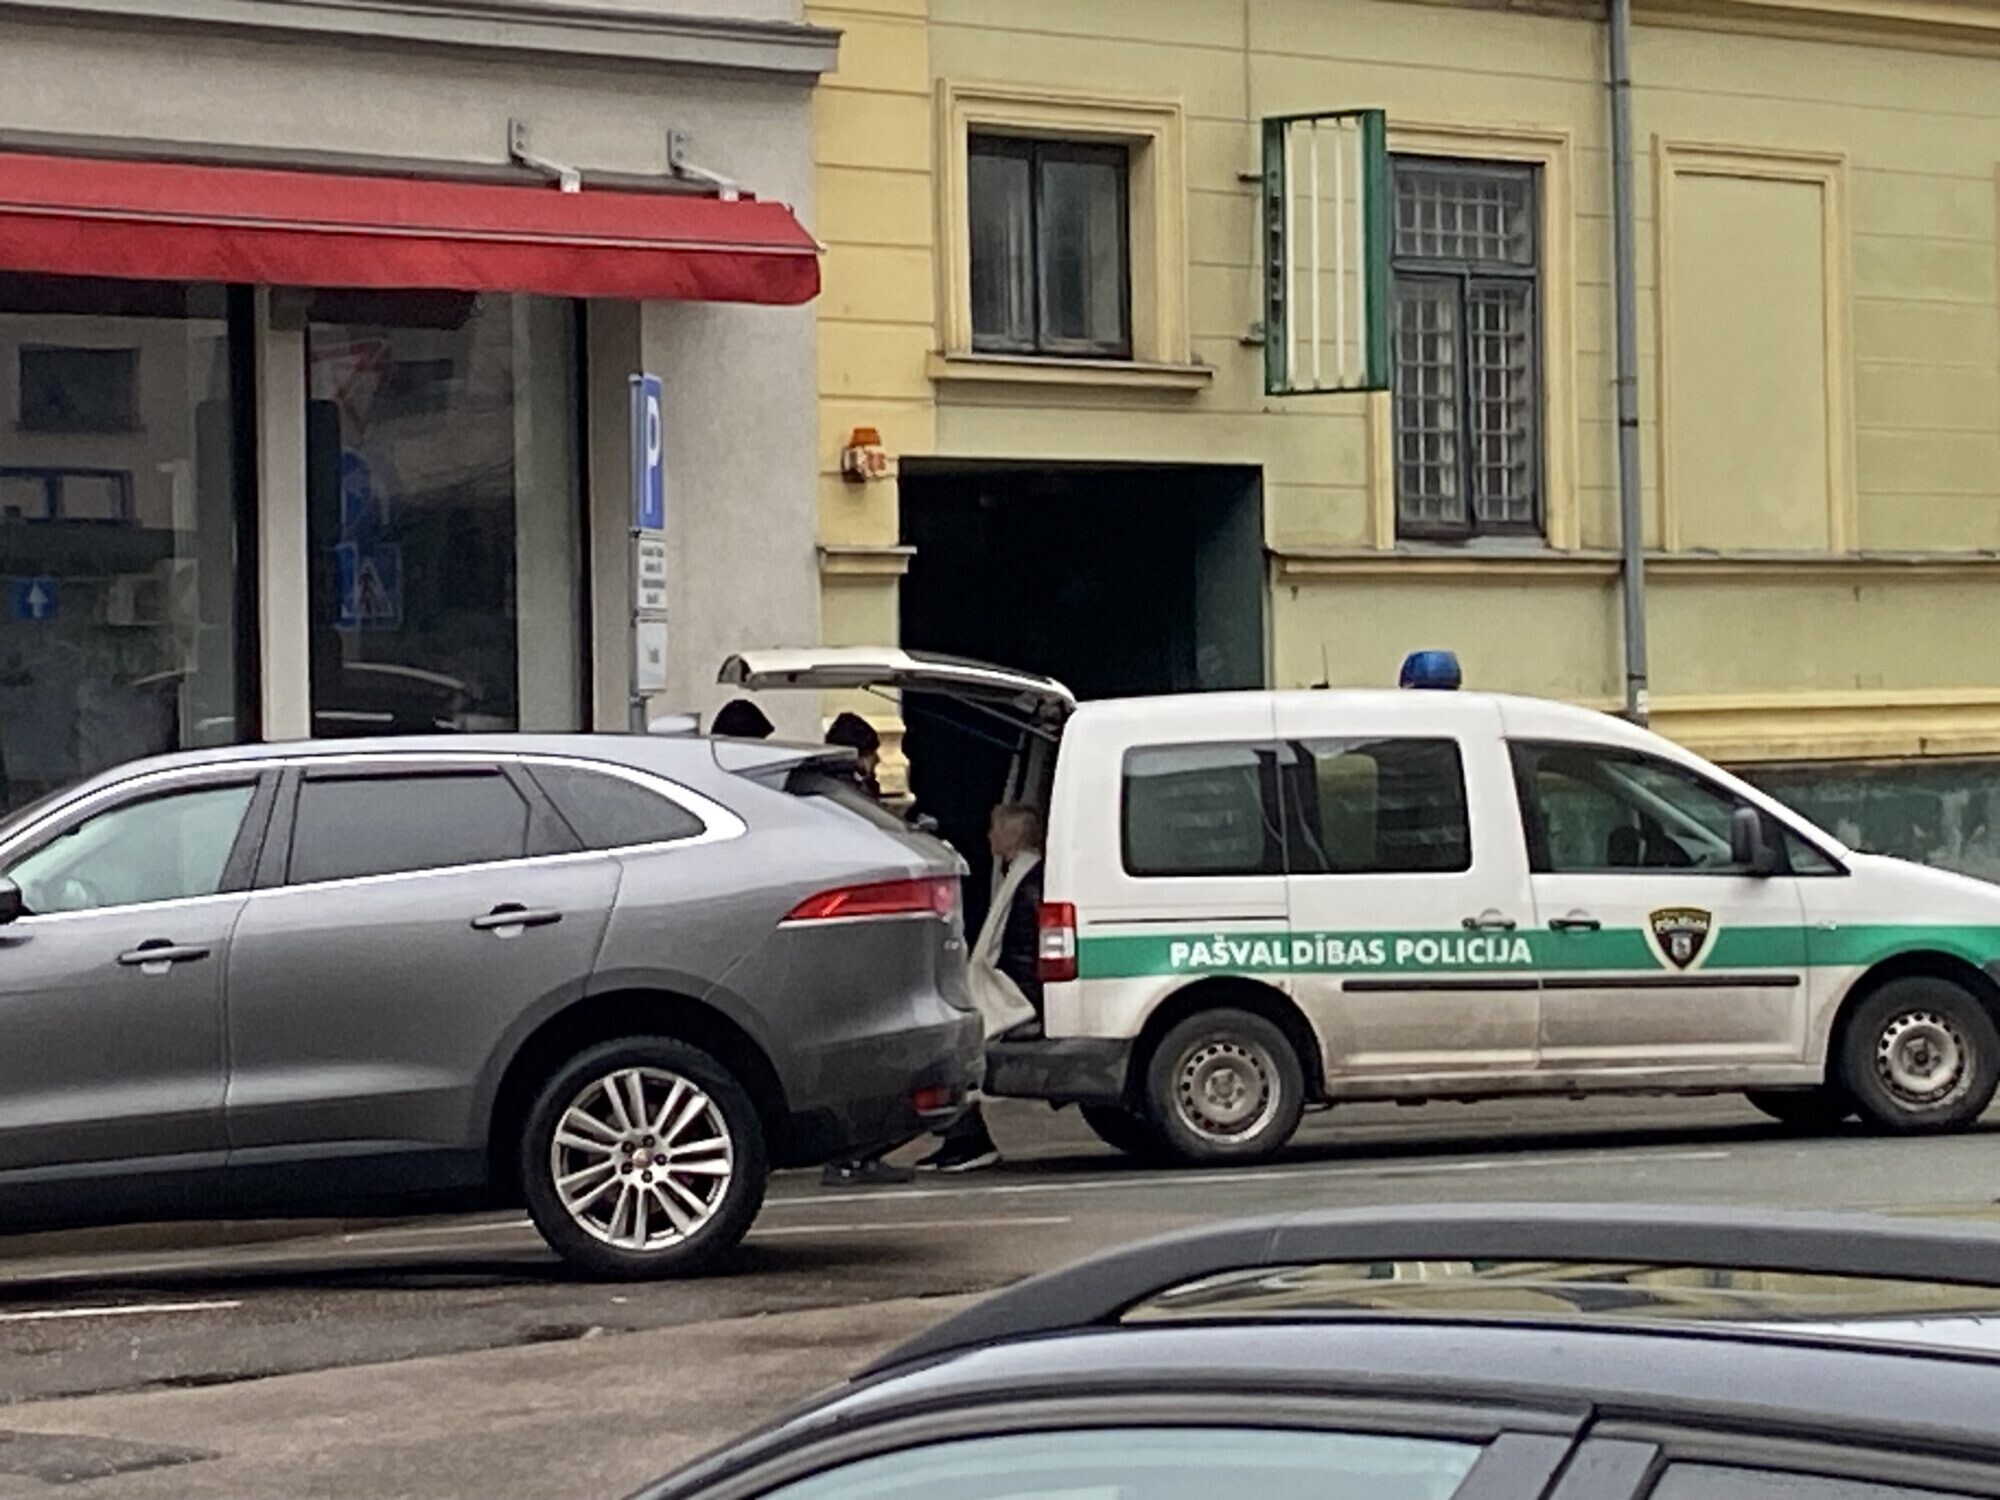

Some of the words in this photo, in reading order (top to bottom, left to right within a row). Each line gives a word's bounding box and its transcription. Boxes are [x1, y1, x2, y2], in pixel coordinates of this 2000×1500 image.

[645, 395, 661, 514] P
[1170, 934, 1386, 967] PAŠVALDĪBAS
[1395, 937, 1533, 965] POLICIJA
